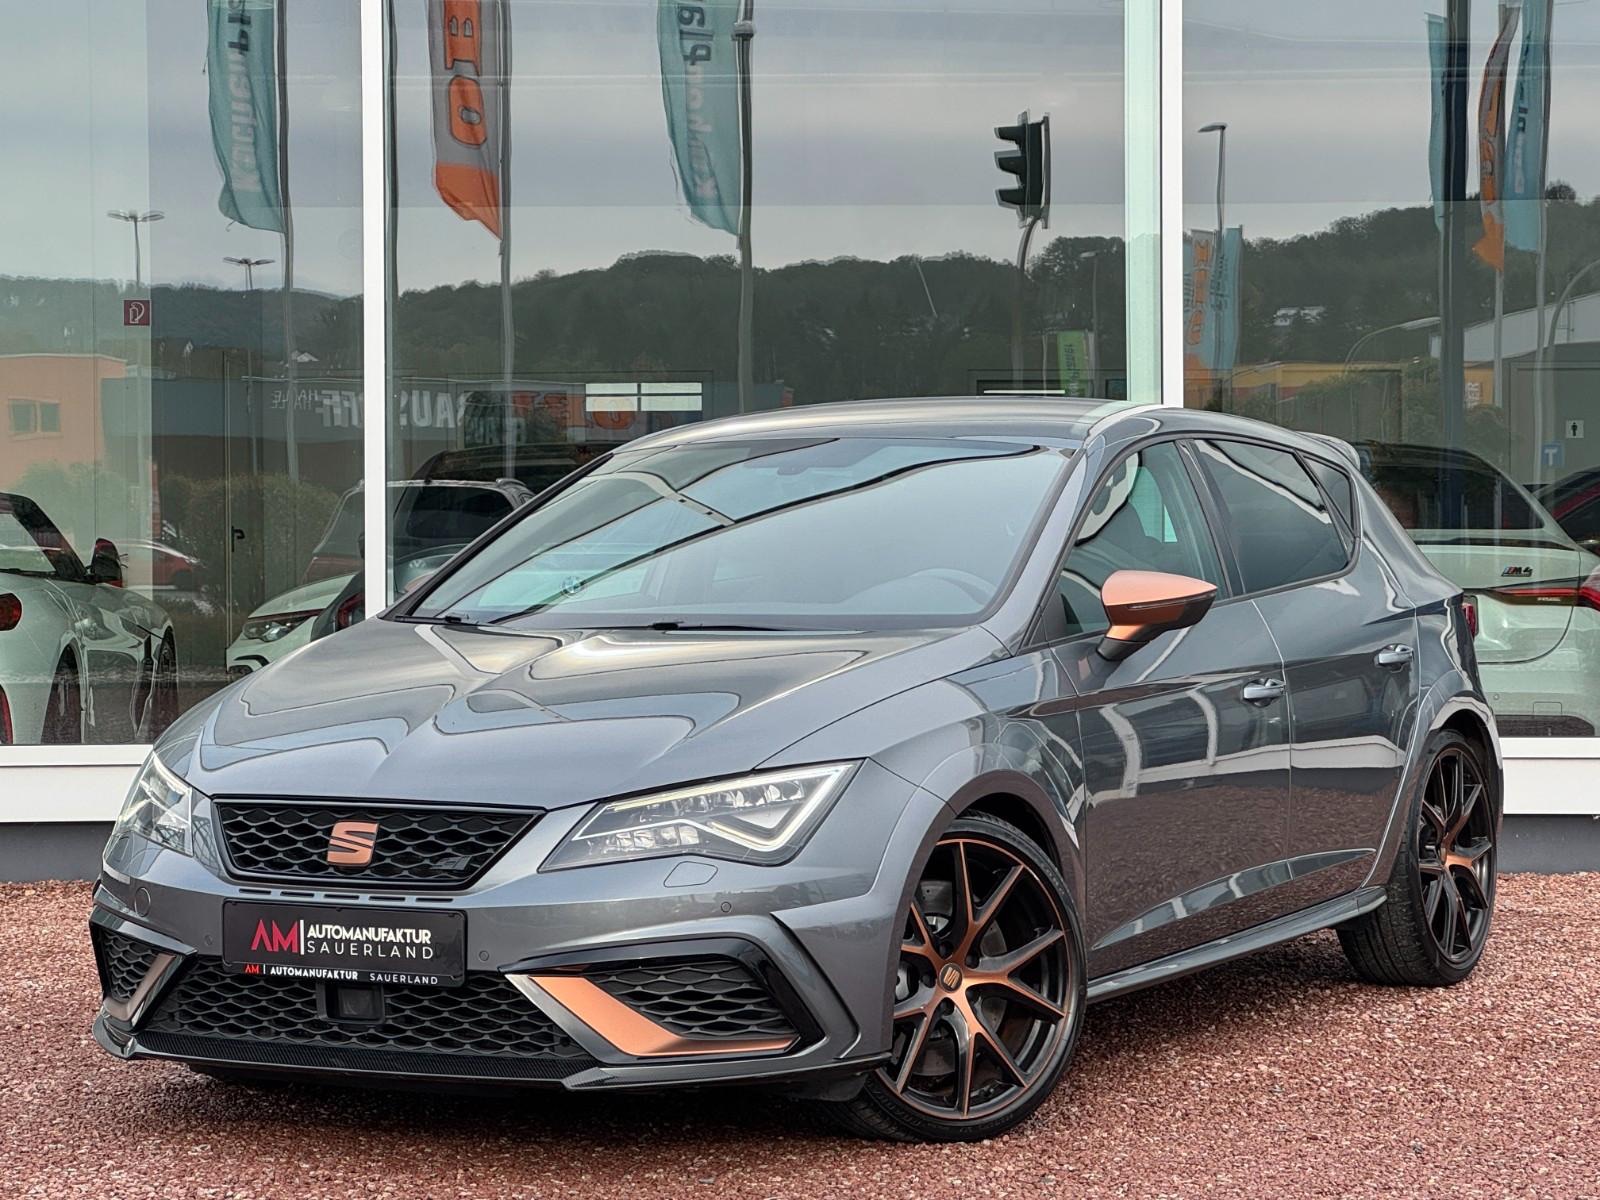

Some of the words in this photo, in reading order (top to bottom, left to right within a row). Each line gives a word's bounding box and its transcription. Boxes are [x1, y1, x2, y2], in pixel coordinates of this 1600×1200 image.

[250, 919, 298, 953] AM
[307, 924, 432, 945] AUTOMANUFAKTUR
[307, 940, 434, 960] SAUERLAND
[244, 964, 260, 975] AM
[270, 966, 358, 981] AUTOMANUFAKTUR
[369, 973, 439, 985] SAUERLAND
